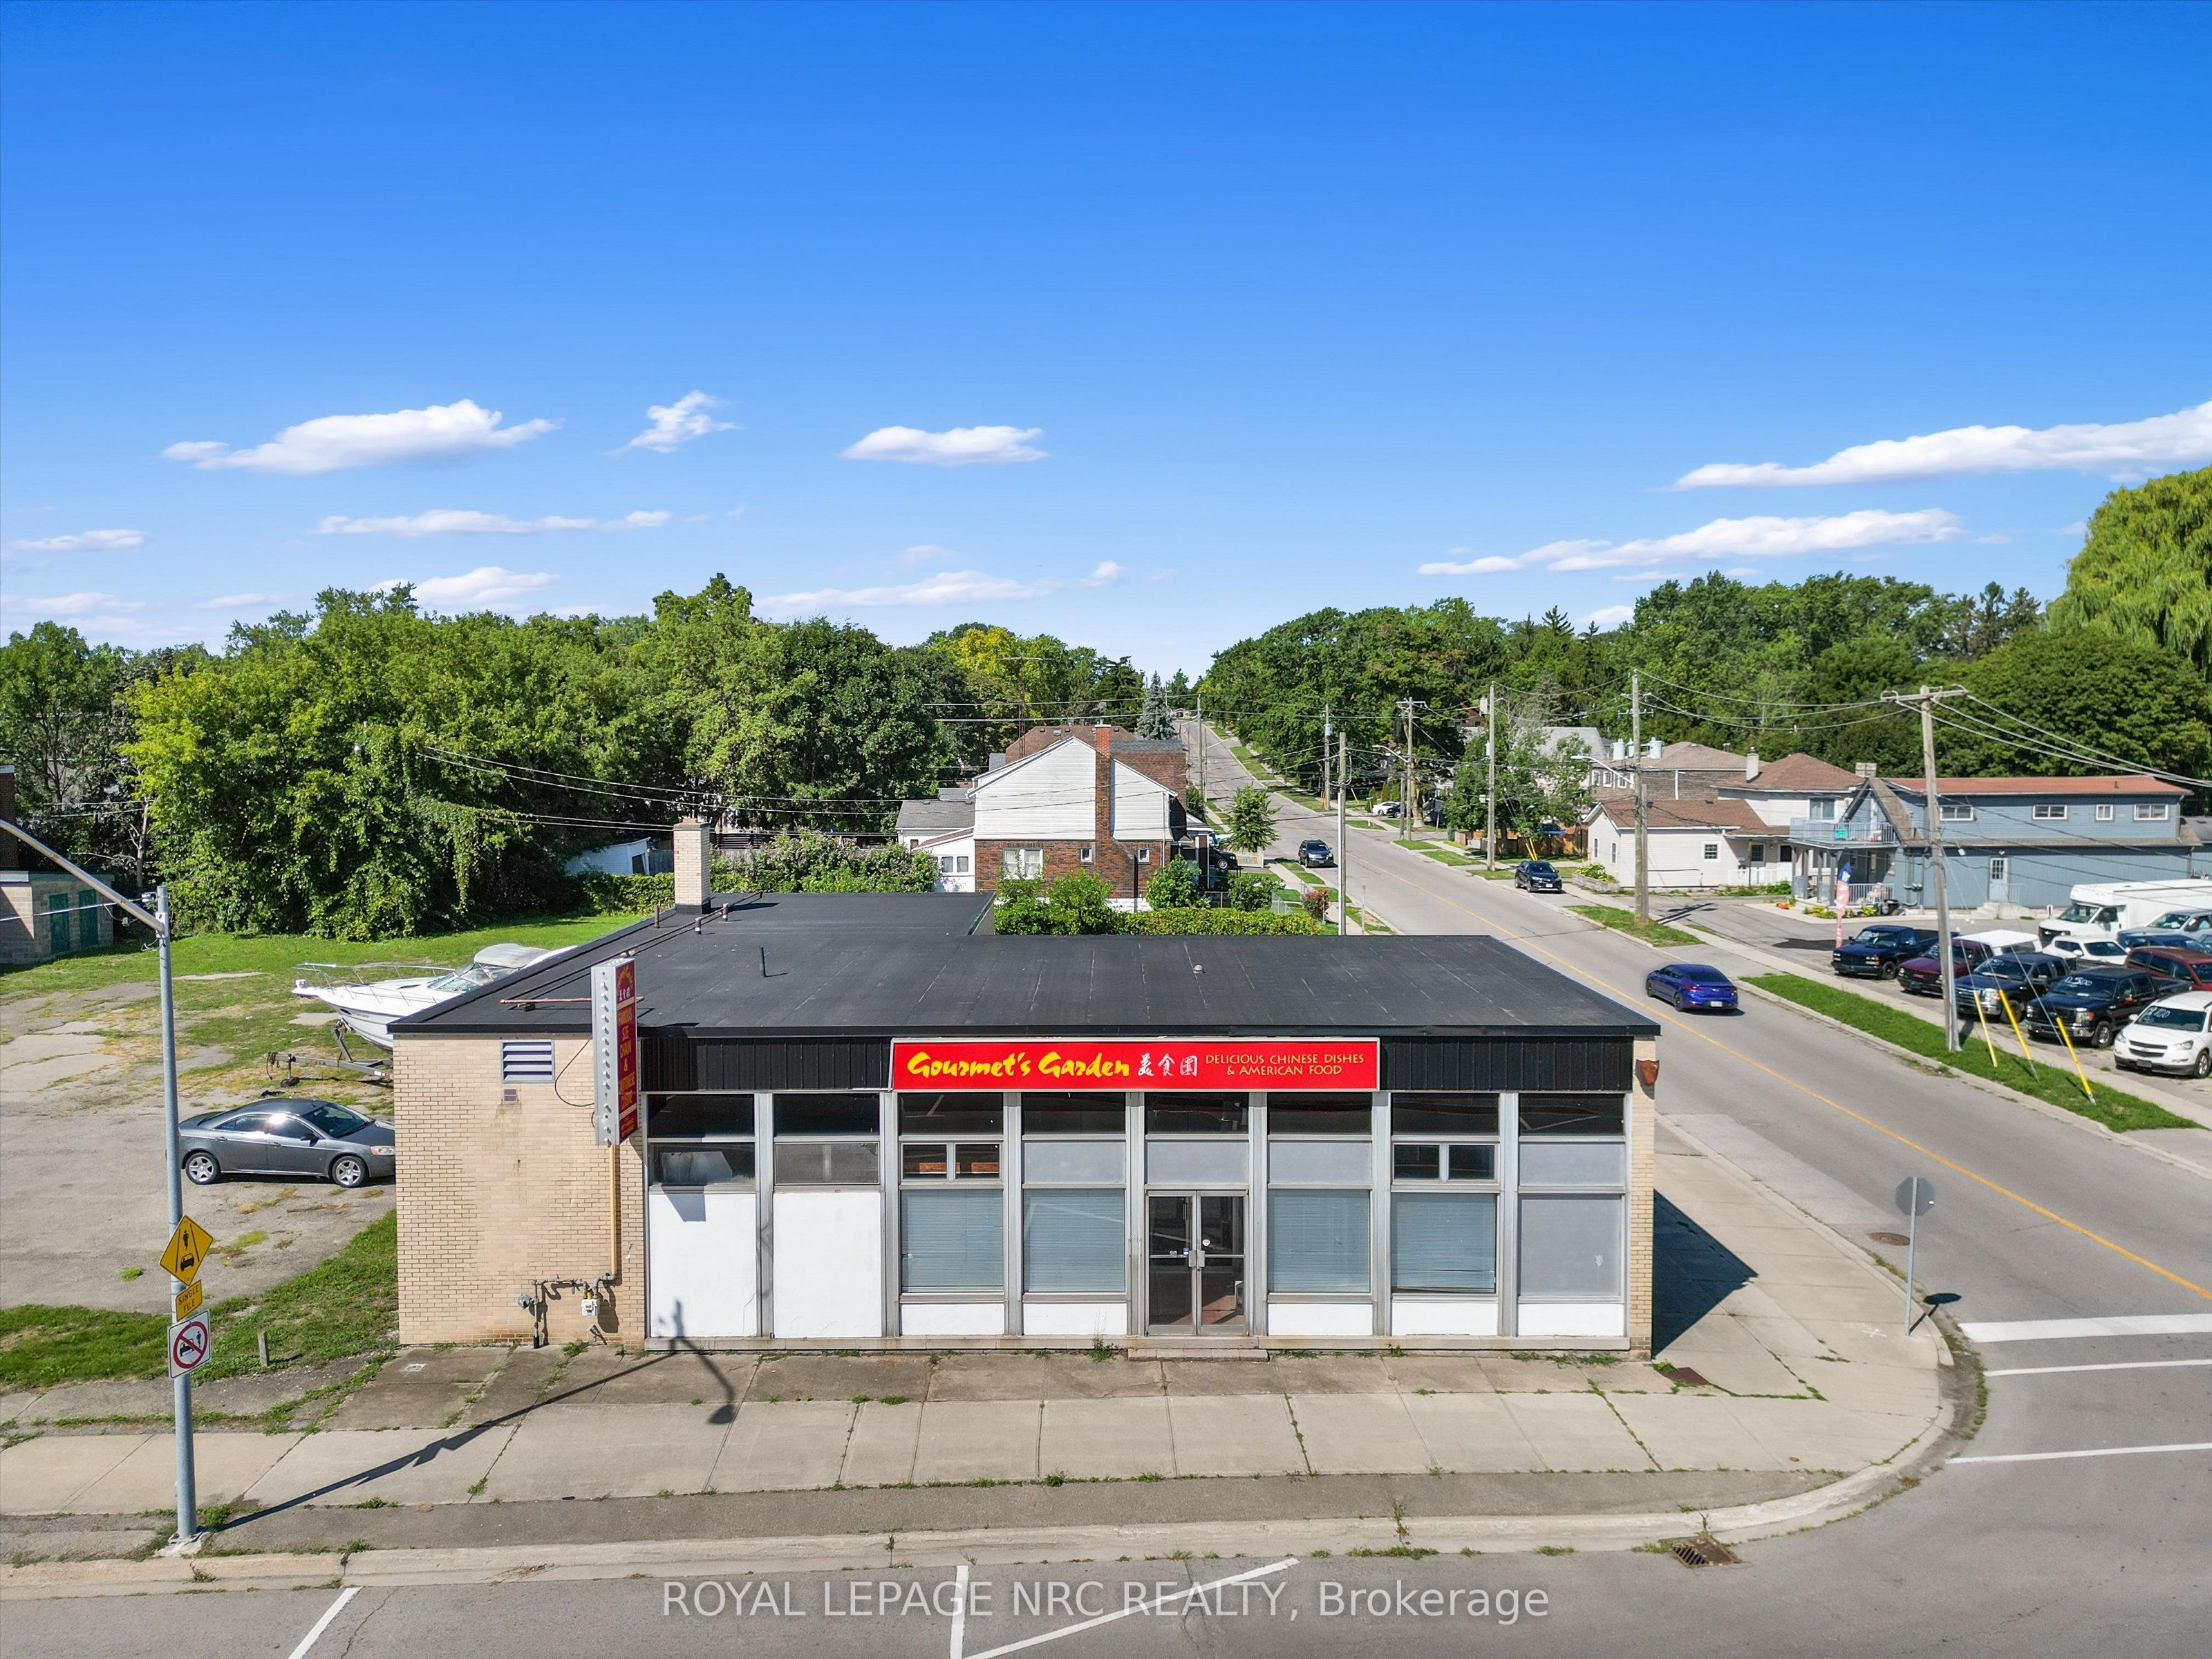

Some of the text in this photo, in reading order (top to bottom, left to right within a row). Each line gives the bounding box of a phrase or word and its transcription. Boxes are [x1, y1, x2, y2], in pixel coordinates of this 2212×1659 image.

[907, 1051, 1130, 1078] Gourmet's Garden
[1206, 1054, 1365, 1065] DELICIOUS CHINESE DISHES
[1226, 1065, 1342, 1076] & AMERICAN FOOD
[178, 1284, 199, 1305] SINGLE
[183, 1299, 195, 1313] FILE
